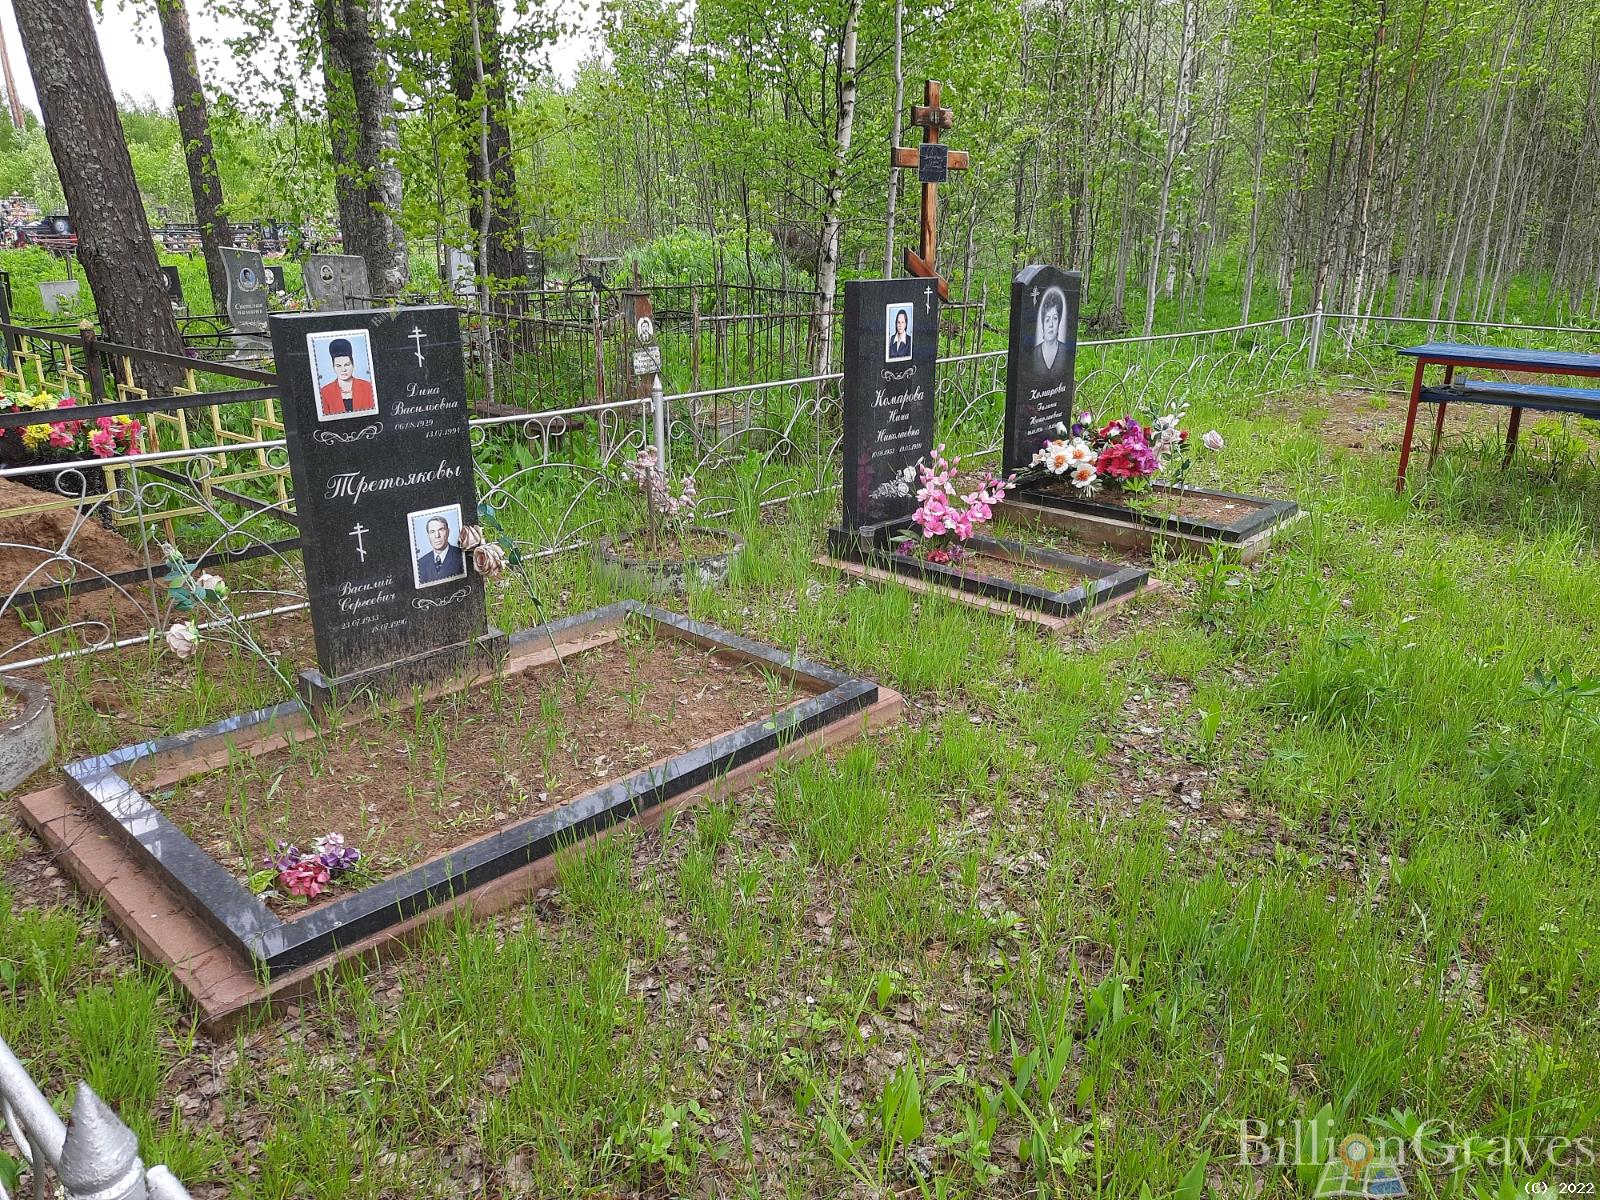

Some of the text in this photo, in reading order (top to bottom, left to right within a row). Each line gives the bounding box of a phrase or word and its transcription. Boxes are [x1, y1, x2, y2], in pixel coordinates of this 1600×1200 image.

[406, 382, 440, 398] Дина
[870, 385, 925, 410] Комарова
[390, 397, 459, 416] Васильевна
[886, 409, 910, 424] Нина
[874, 425, 920, 443] Николаевна
[323, 459, 462, 505] Третьяковы
[337, 574, 394, 597] Василий
[338, 590, 396, 615] Сергеевич
